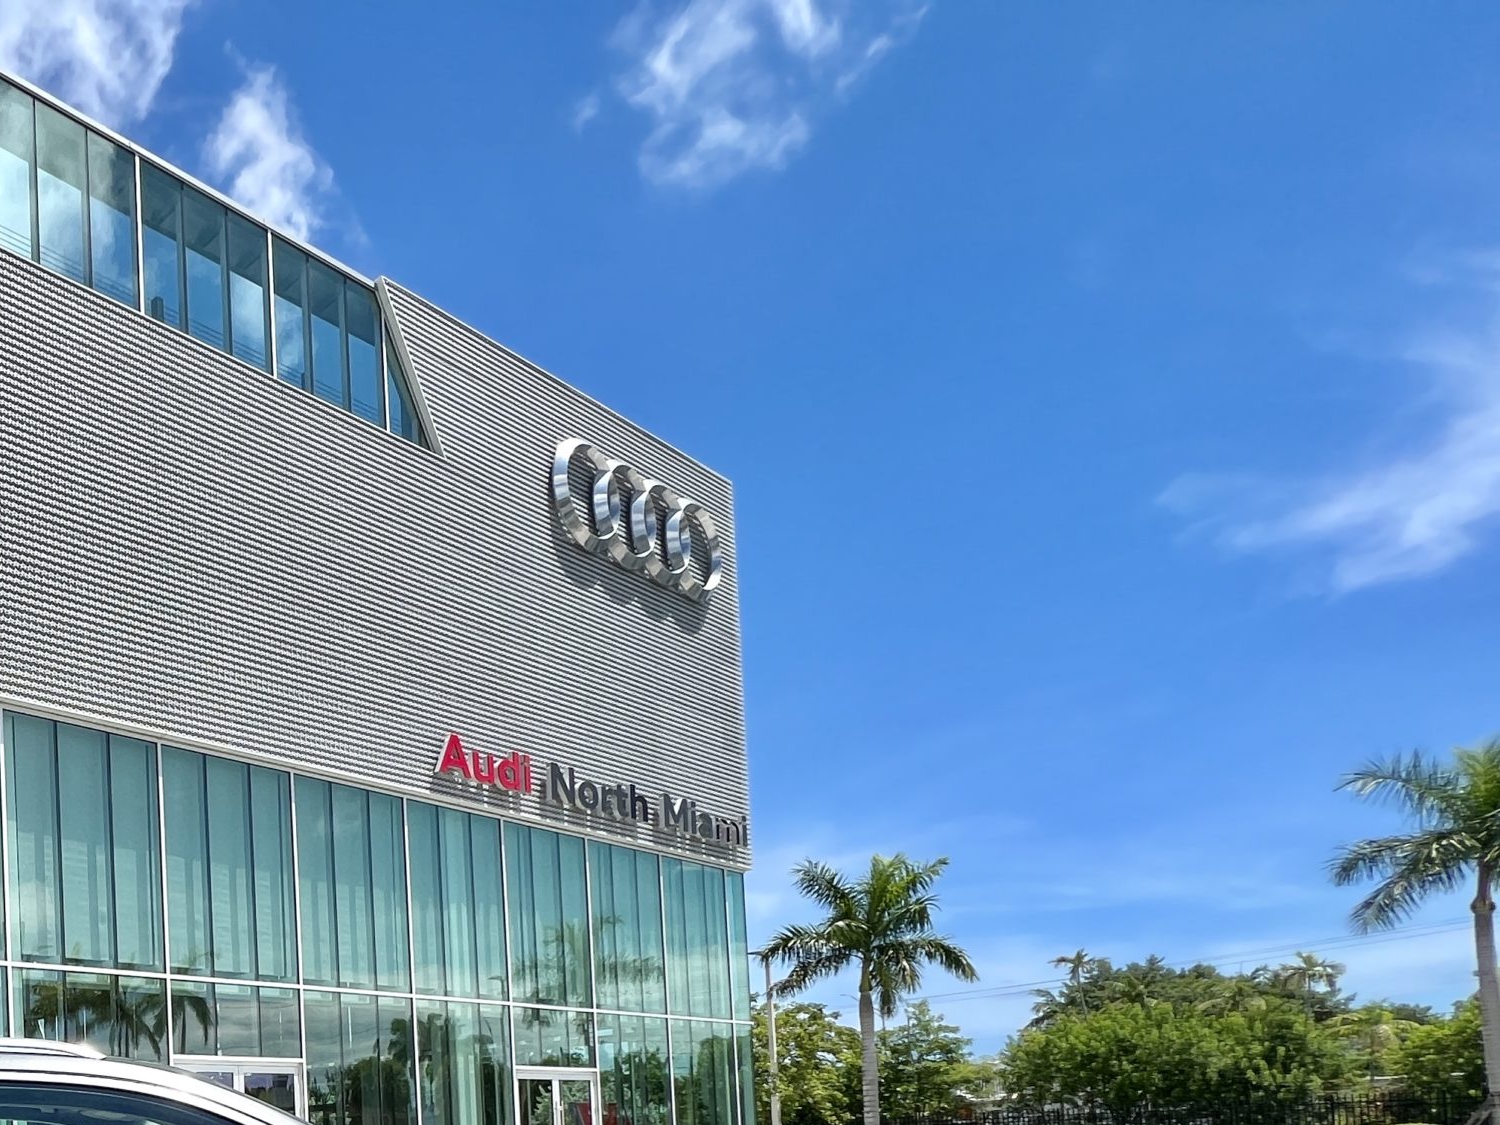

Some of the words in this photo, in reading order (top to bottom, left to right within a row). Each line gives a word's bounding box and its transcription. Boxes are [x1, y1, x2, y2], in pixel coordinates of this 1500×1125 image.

[436, 733, 531, 794] Audi
[547, 762, 649, 822] North
[658, 793, 748, 847] Miami
